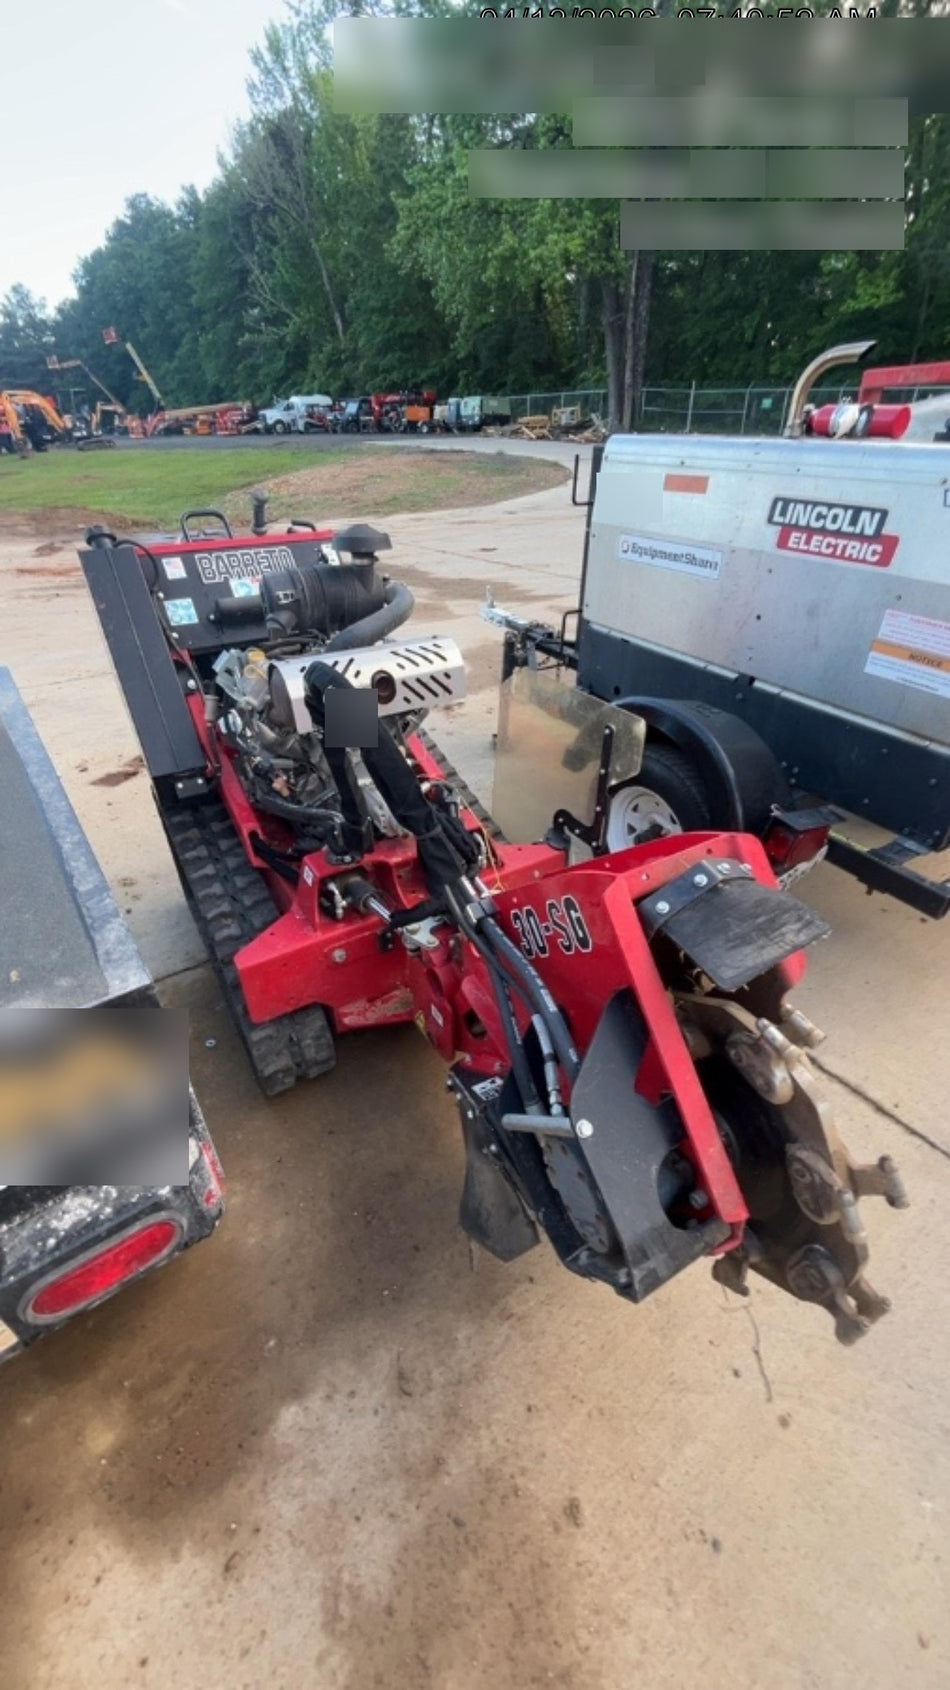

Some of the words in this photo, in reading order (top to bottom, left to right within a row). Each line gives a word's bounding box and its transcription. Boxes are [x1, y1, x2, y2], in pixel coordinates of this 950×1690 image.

[771, 501, 881, 535] LINCOLN
[786, 531, 883, 562] ELECTRIC
[195, 546, 297, 583] BARRETO
[511, 895, 592, 959] 30-SG
